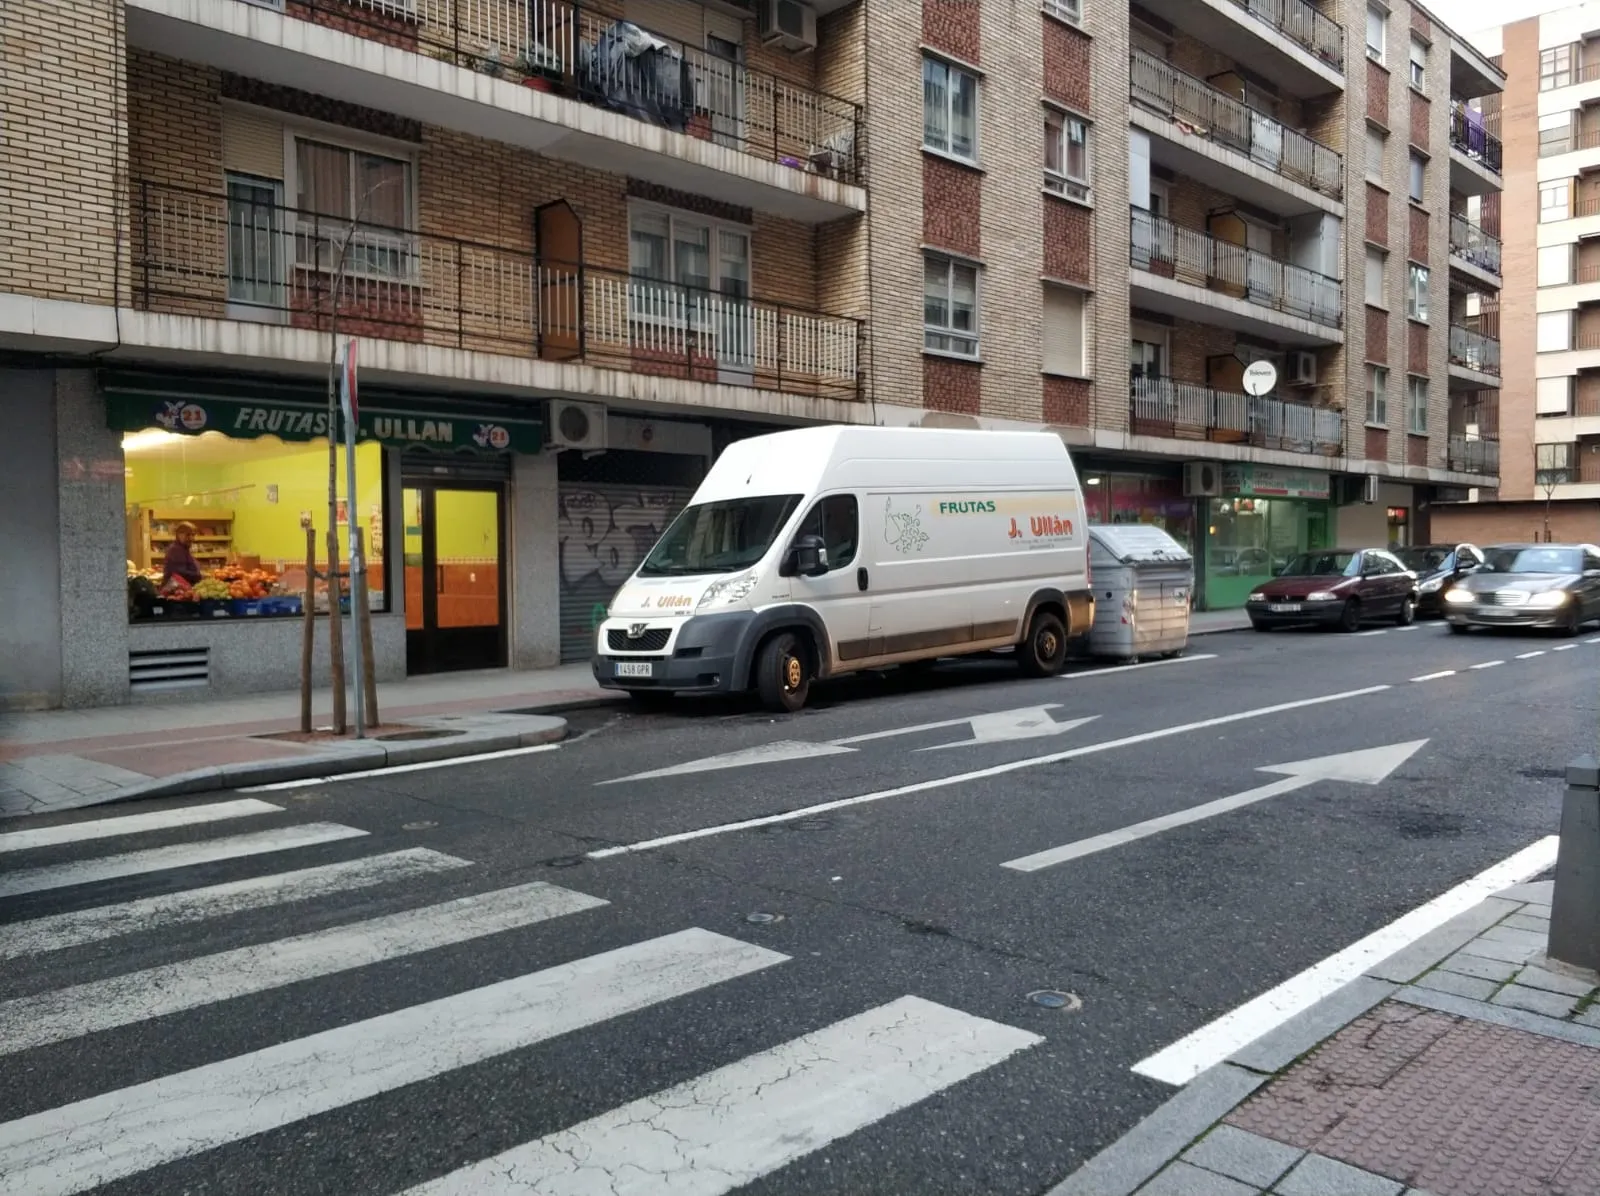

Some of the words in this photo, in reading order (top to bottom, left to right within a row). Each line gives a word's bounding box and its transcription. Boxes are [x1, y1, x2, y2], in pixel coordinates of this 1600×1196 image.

[234, 407, 329, 434] FRUTAS
[374, 417, 453, 442] ULLAN
[939, 501, 996, 514] FRUTAS
[1008, 517, 1022, 538] J.
